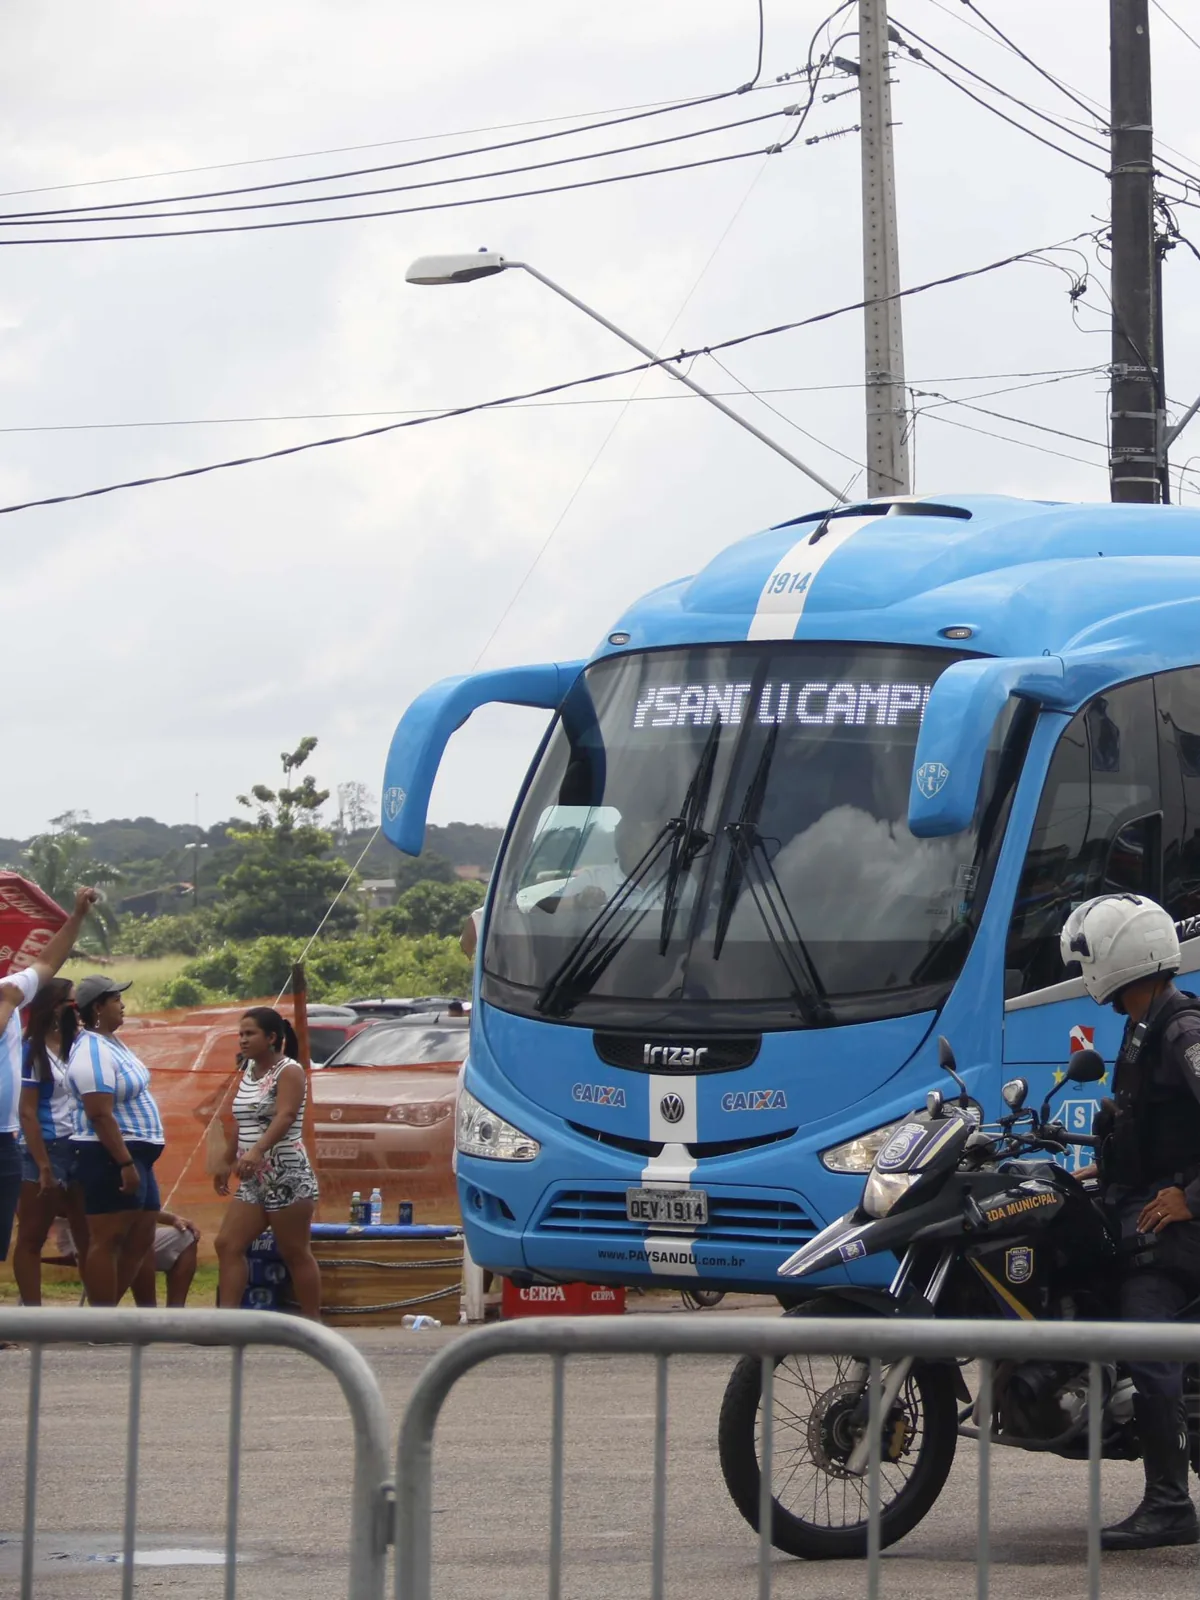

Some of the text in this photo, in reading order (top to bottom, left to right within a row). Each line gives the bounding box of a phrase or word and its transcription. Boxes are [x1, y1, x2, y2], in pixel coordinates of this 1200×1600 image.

[767, 572, 812, 594] 1914
[796, 683, 932, 725] CAMP
[643, 1043, 708, 1066] Irizar
[572, 1082, 788, 1112] CAIXA CAIXA
[1006, 1192, 1058, 1216] MUNICIPAL
[598, 1249, 746, 1267] www.PAYSANDU.com.br
[519, 1286, 616, 1301] CERPA CERPA
